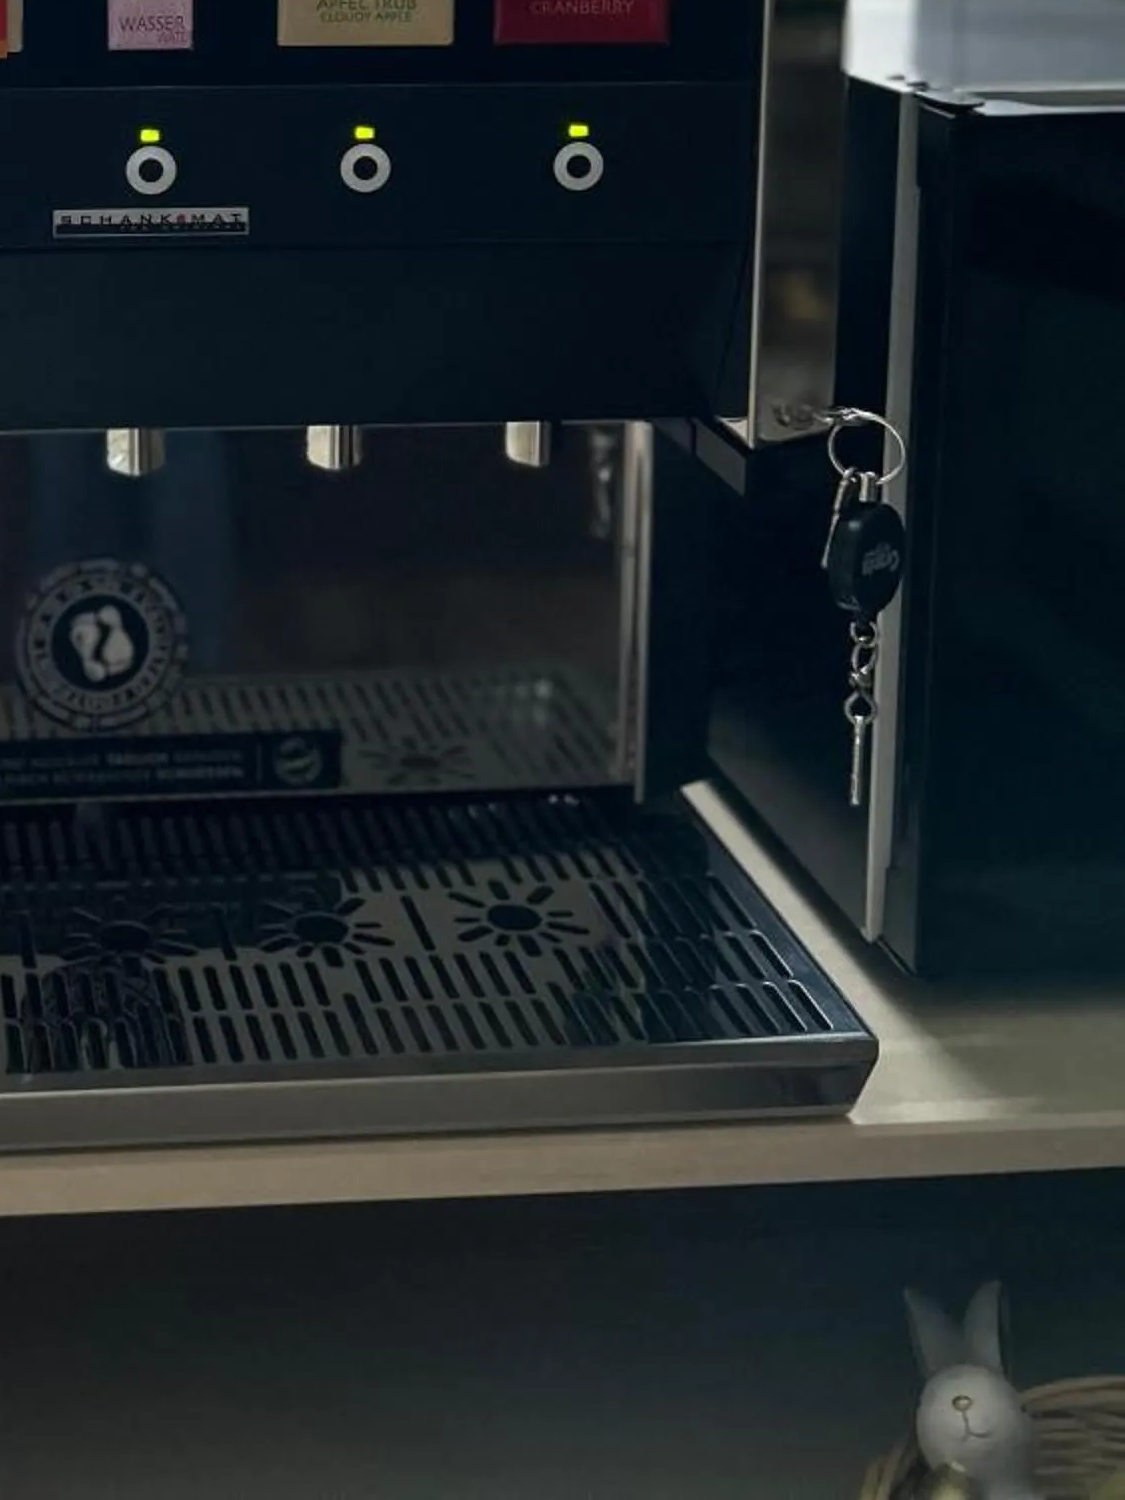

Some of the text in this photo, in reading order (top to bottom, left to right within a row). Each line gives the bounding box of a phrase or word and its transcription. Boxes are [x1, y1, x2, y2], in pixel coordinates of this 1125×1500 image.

[529, 0, 635, 16] CRANBERRY
[118, 14, 186, 32] WASSER
[319, 11, 414, 22] CLOUDY APPLE
